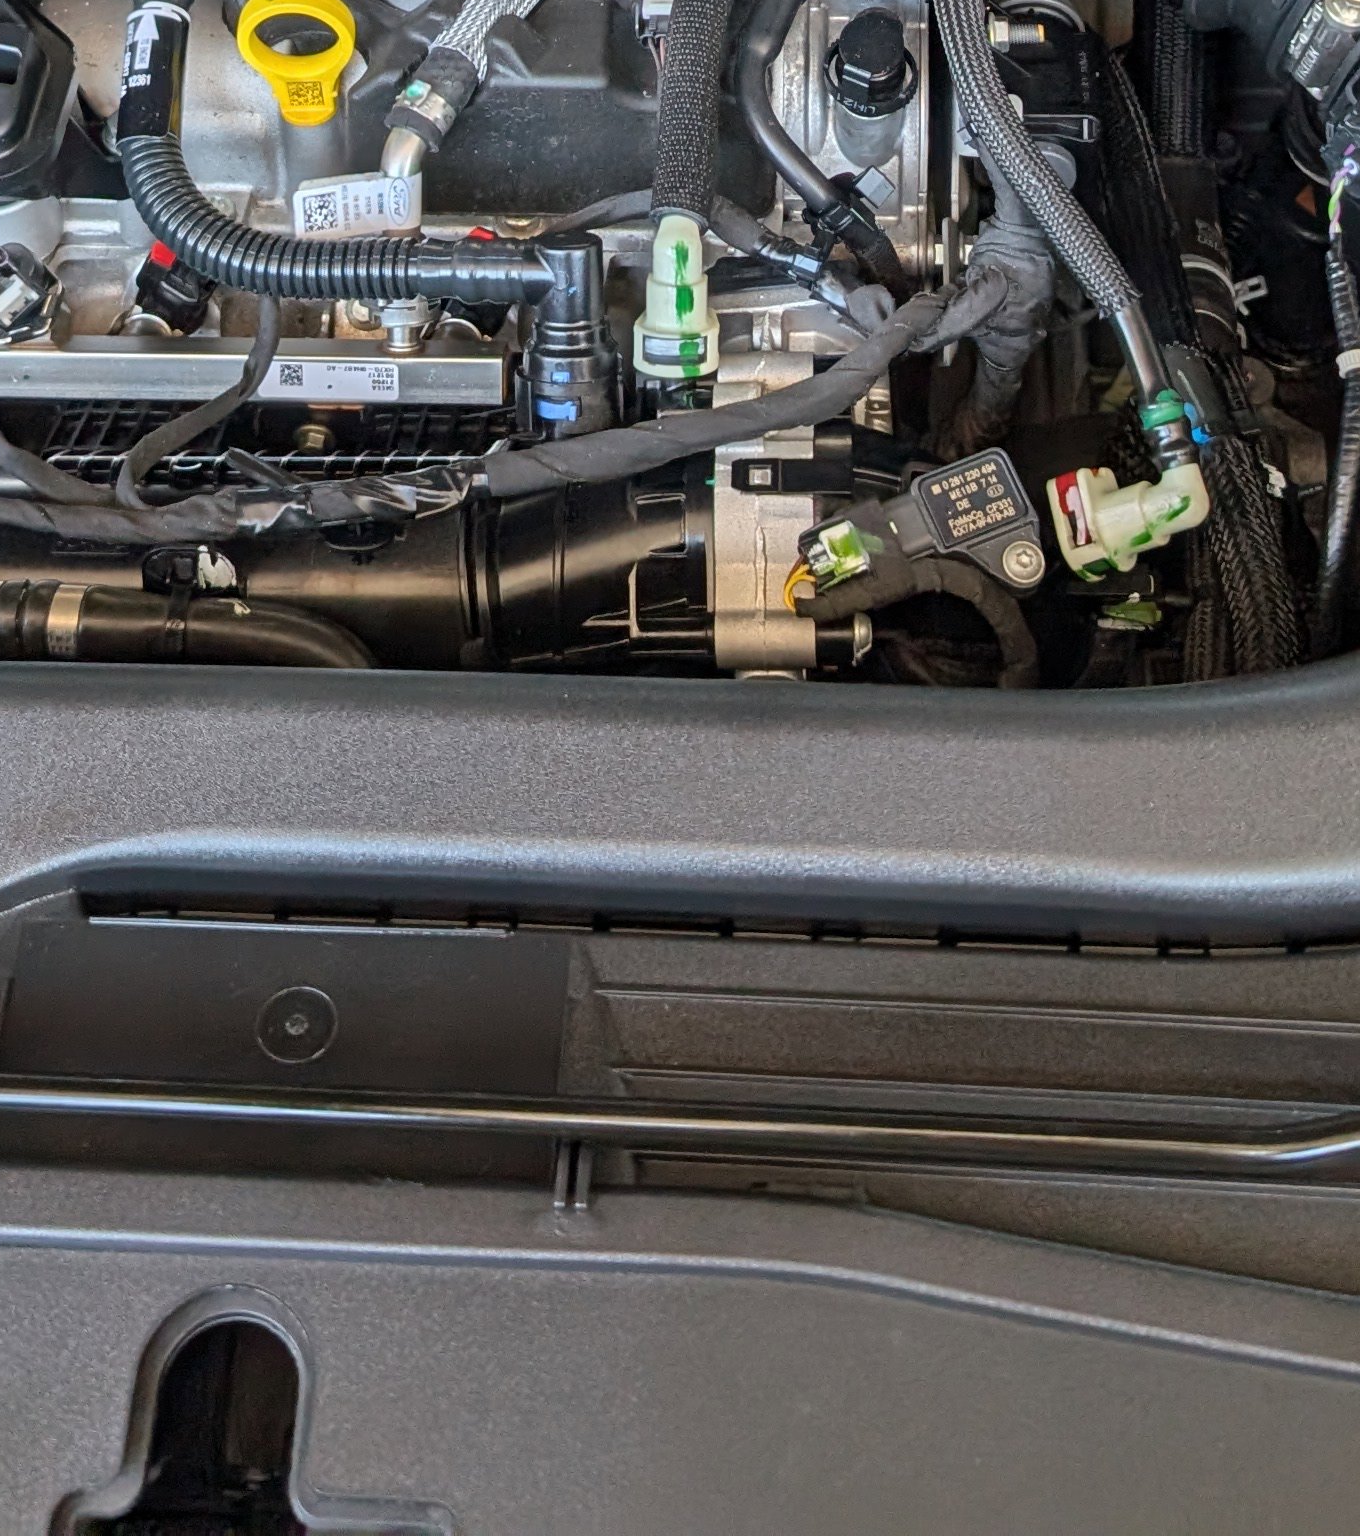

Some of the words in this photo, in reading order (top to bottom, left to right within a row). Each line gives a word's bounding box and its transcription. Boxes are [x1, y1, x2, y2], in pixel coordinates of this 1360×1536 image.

[942, 481, 949, 490] 0
[956, 498, 971, 511] DE
[948, 511, 984, 528] FoMoCo
